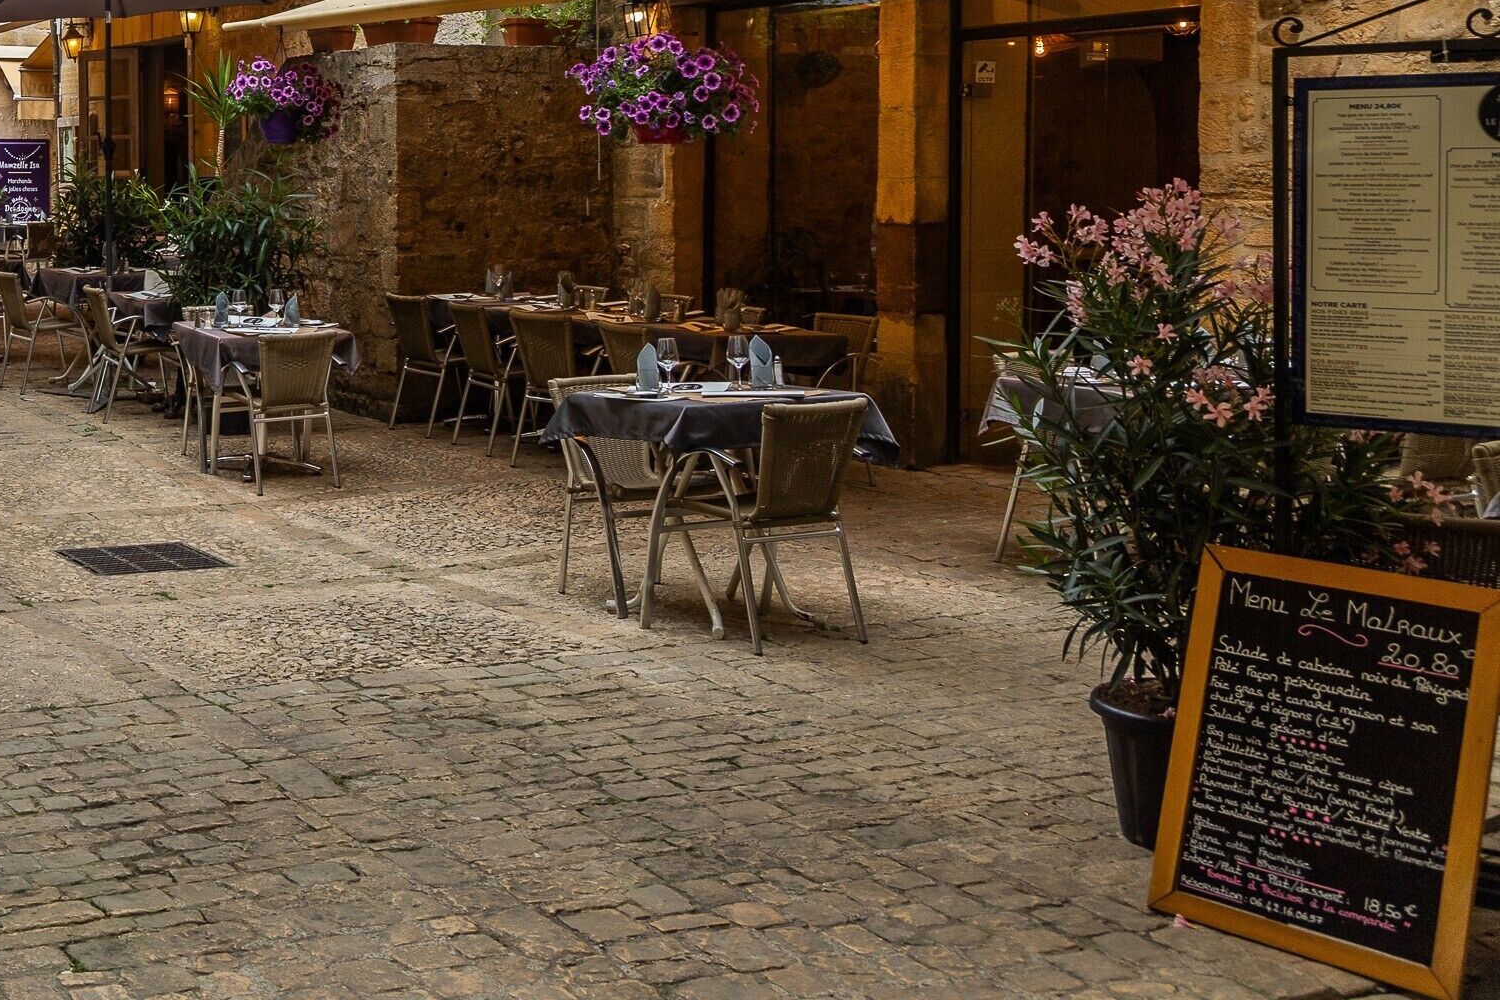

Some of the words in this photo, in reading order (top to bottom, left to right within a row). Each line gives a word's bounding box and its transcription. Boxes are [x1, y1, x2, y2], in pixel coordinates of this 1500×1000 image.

[1230, 578, 1289, 614] Menu
[1300, 590, 1335, 622] Le
[1214, 634, 1270, 661] Salade
[1276, 652, 1292, 666] de
[1361, 672, 1390, 685] noix
[1391, 674, 1411, 690] du
[1214, 656, 1240, 674] Pâté
[1204, 704, 1246, 724] Salade
[1251, 716, 1266, 729] de
[1210, 675, 1230, 690] Foie
[1234, 684, 1264, 698] gras
[1268, 688, 1282, 700] de
[1286, 696, 1335, 712] canard
[1340, 706, 1386, 722] maison
[1388, 715, 1404, 727] et
[1410, 721, 1438, 734] son
